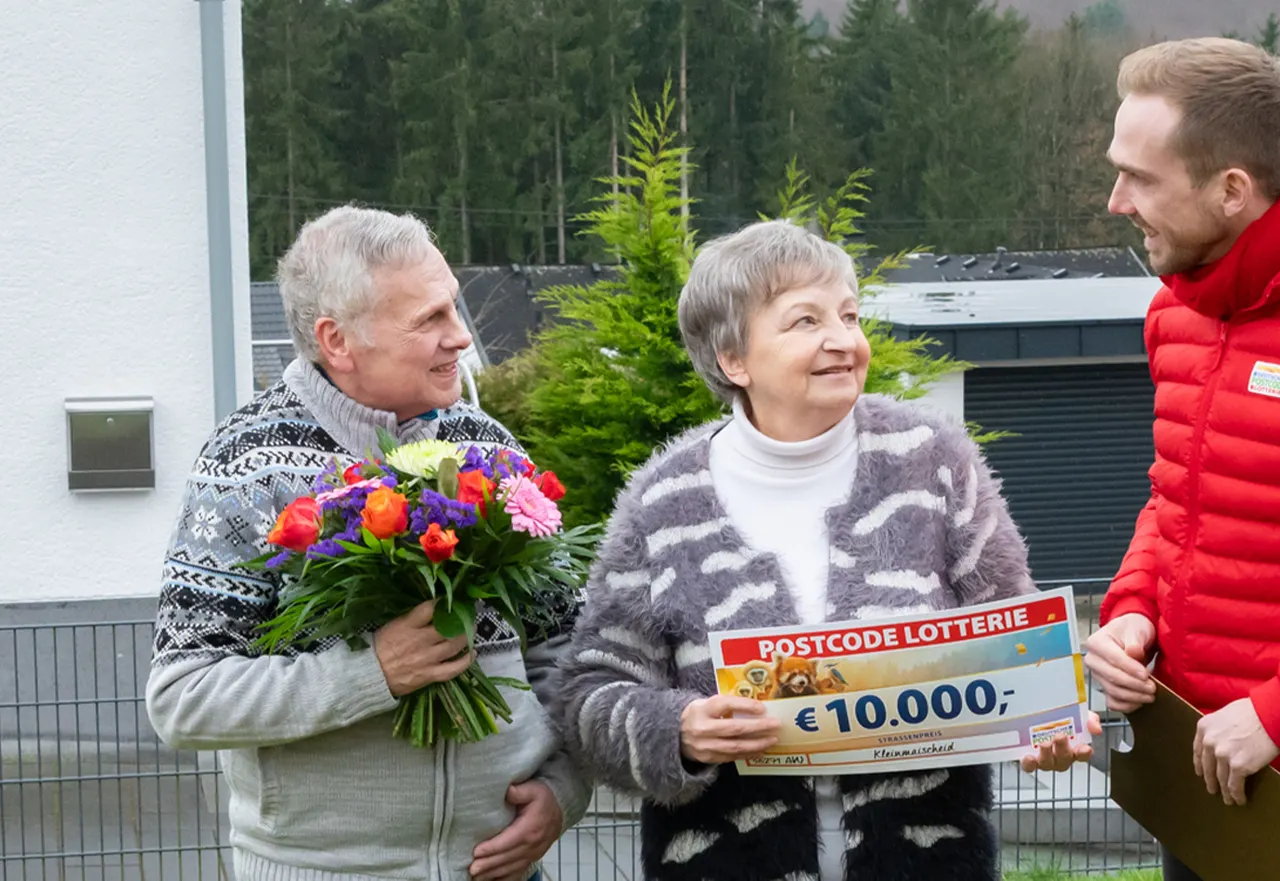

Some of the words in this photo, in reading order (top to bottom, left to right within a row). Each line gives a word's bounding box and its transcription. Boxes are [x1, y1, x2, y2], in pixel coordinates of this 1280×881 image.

[758, 627, 899, 660] POSTCODE
[903, 607, 1029, 645] LOTTERIE
[794, 706, 819, 732] €
[825, 678, 1016, 733] 10.000,-
[873, 741, 956, 760] Kleinmaischeid
[877, 730, 943, 744] STRASSENPREIS
